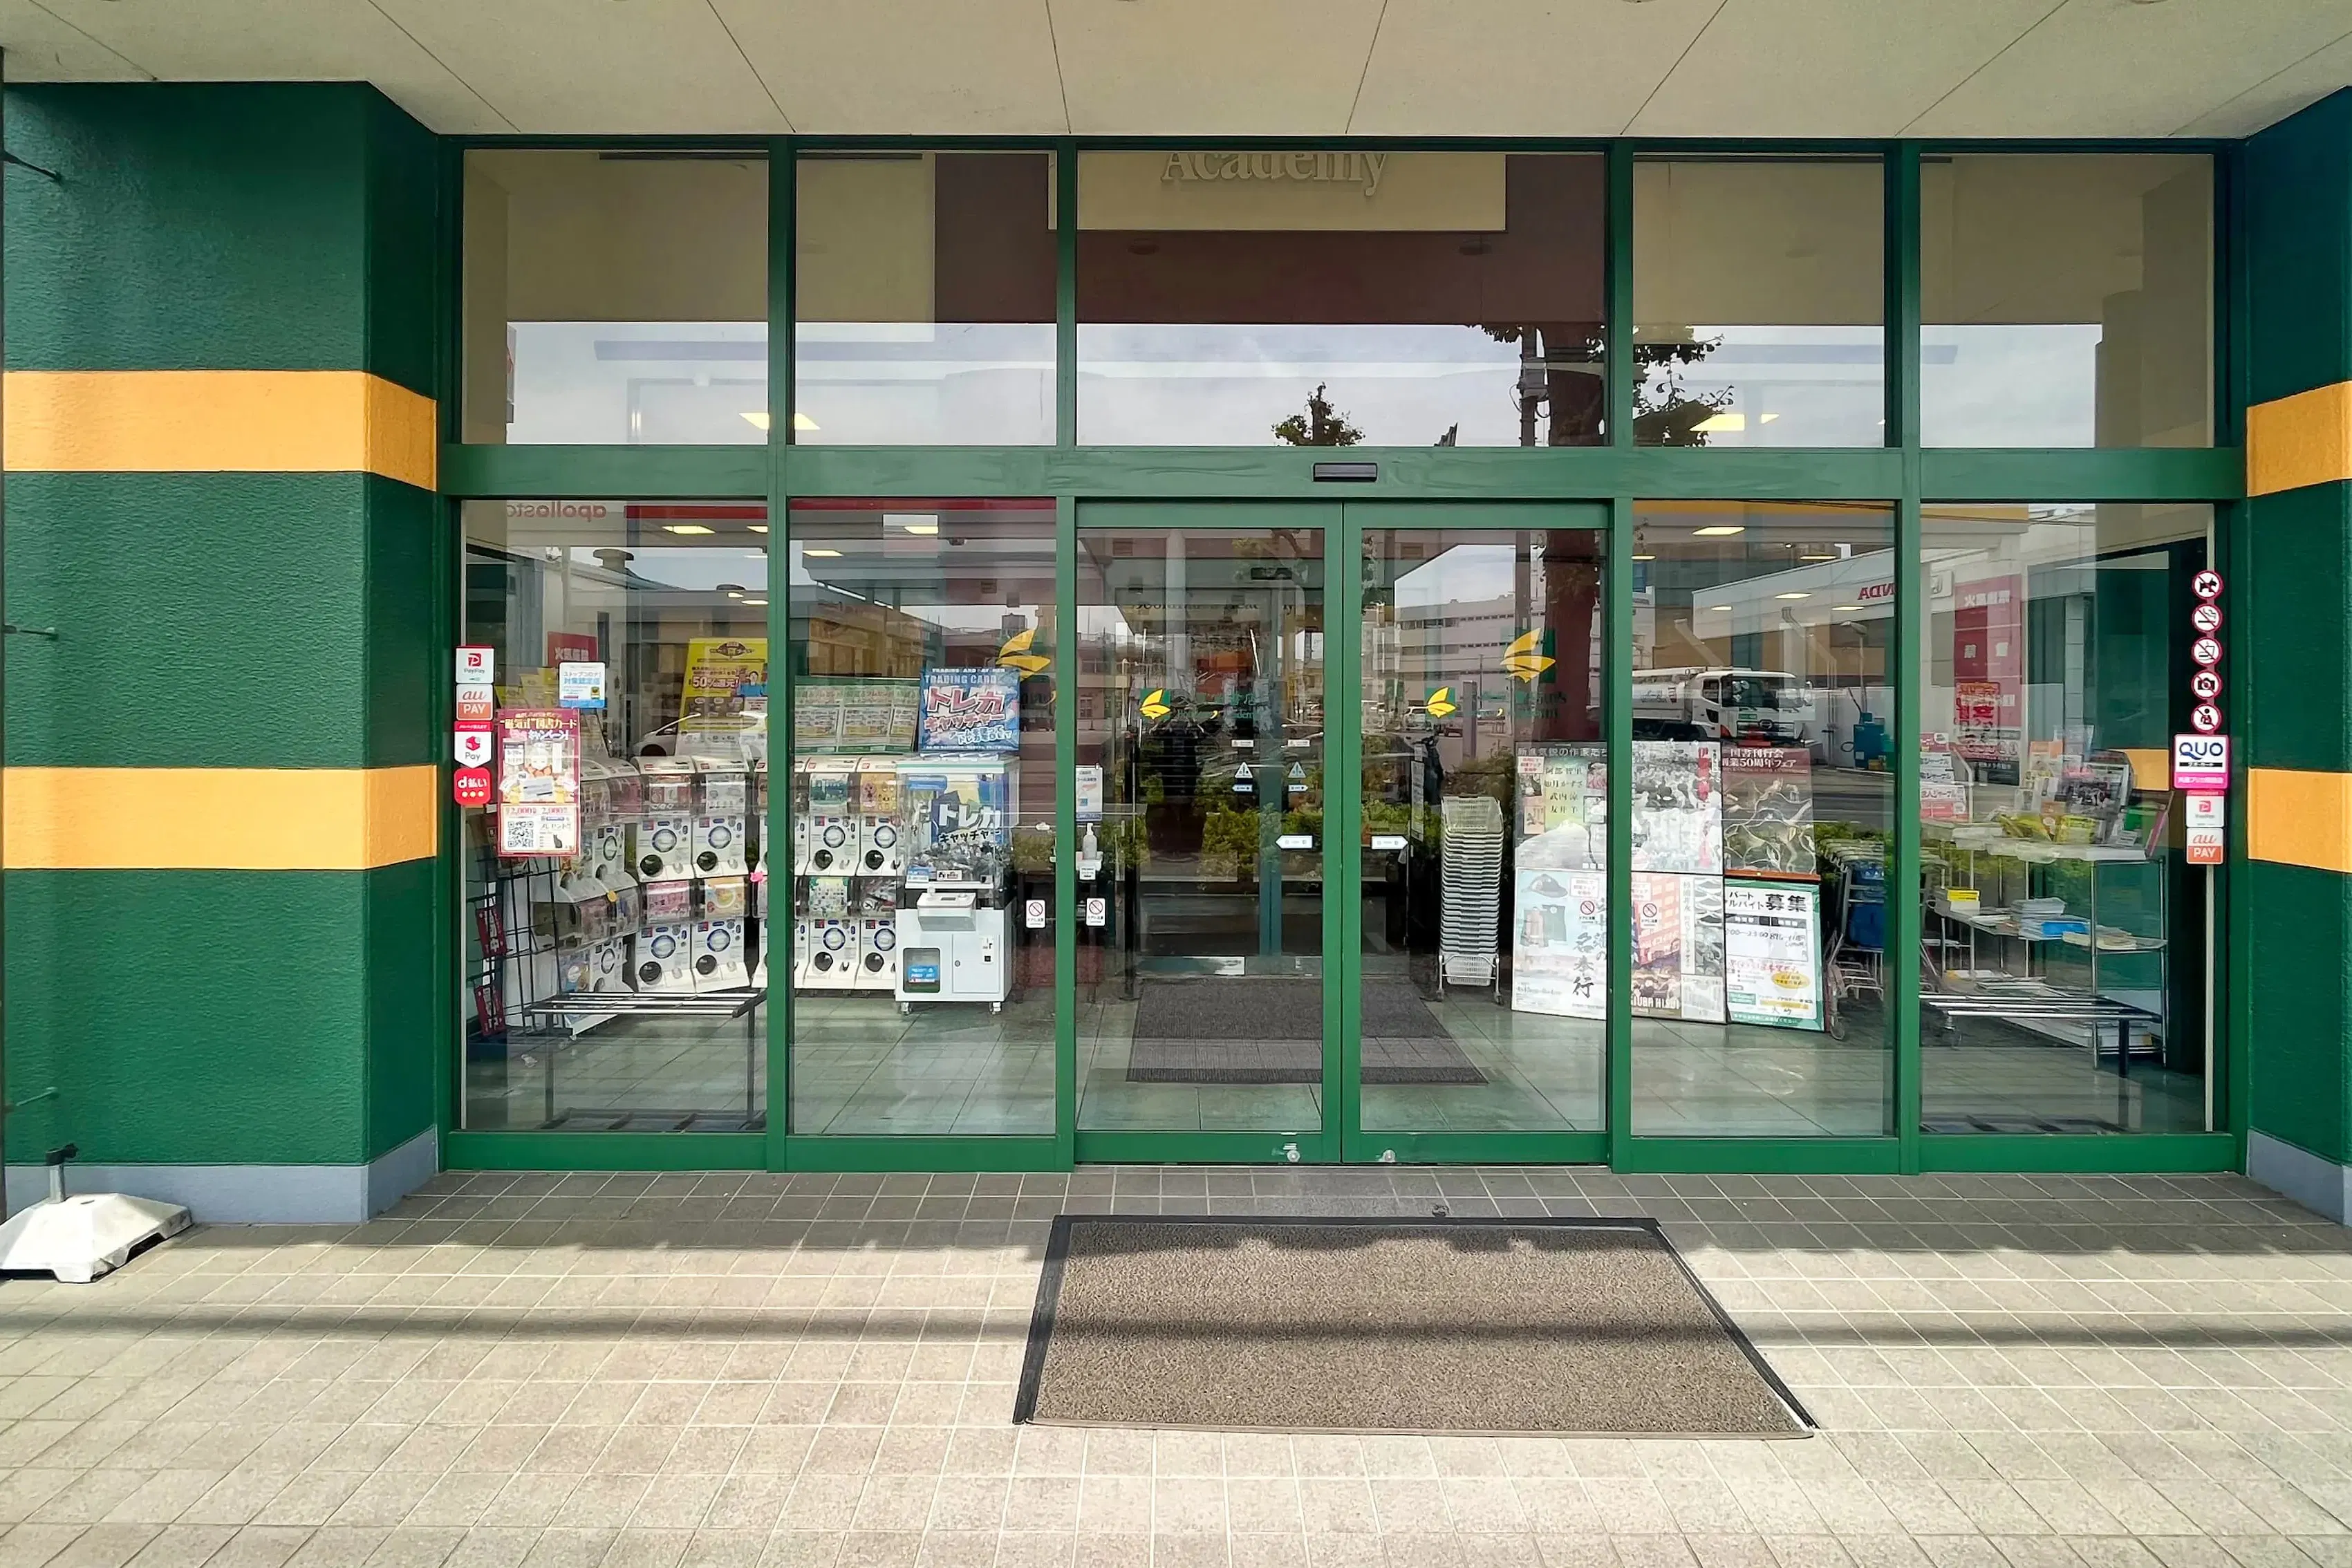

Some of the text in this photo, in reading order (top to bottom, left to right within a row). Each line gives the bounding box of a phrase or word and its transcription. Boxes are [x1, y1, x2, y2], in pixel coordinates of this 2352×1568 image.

[924, 675, 968, 684] TRADING
[462, 691, 486, 700] au
[927, 685, 1005, 715] トレカ
[463, 704, 486, 714] PAY
[924, 712, 1005, 732] キャッチャー
[465, 752, 480, 761] Pay
[1730, 748, 1784, 758] 国書刊行会
[2179, 742, 2223, 760] QUO
[458, 776, 487, 788] d払い
[939, 804, 1002, 829] トレカ
[940, 830, 1001, 843] キャッチャー
[2192, 834, 2216, 843] au
[2193, 847, 2217, 858] PAY
[1729, 891, 1754, 900] パート
[1726, 899, 1764, 910] ルバイト
[1765, 894, 1807, 912] 募集
